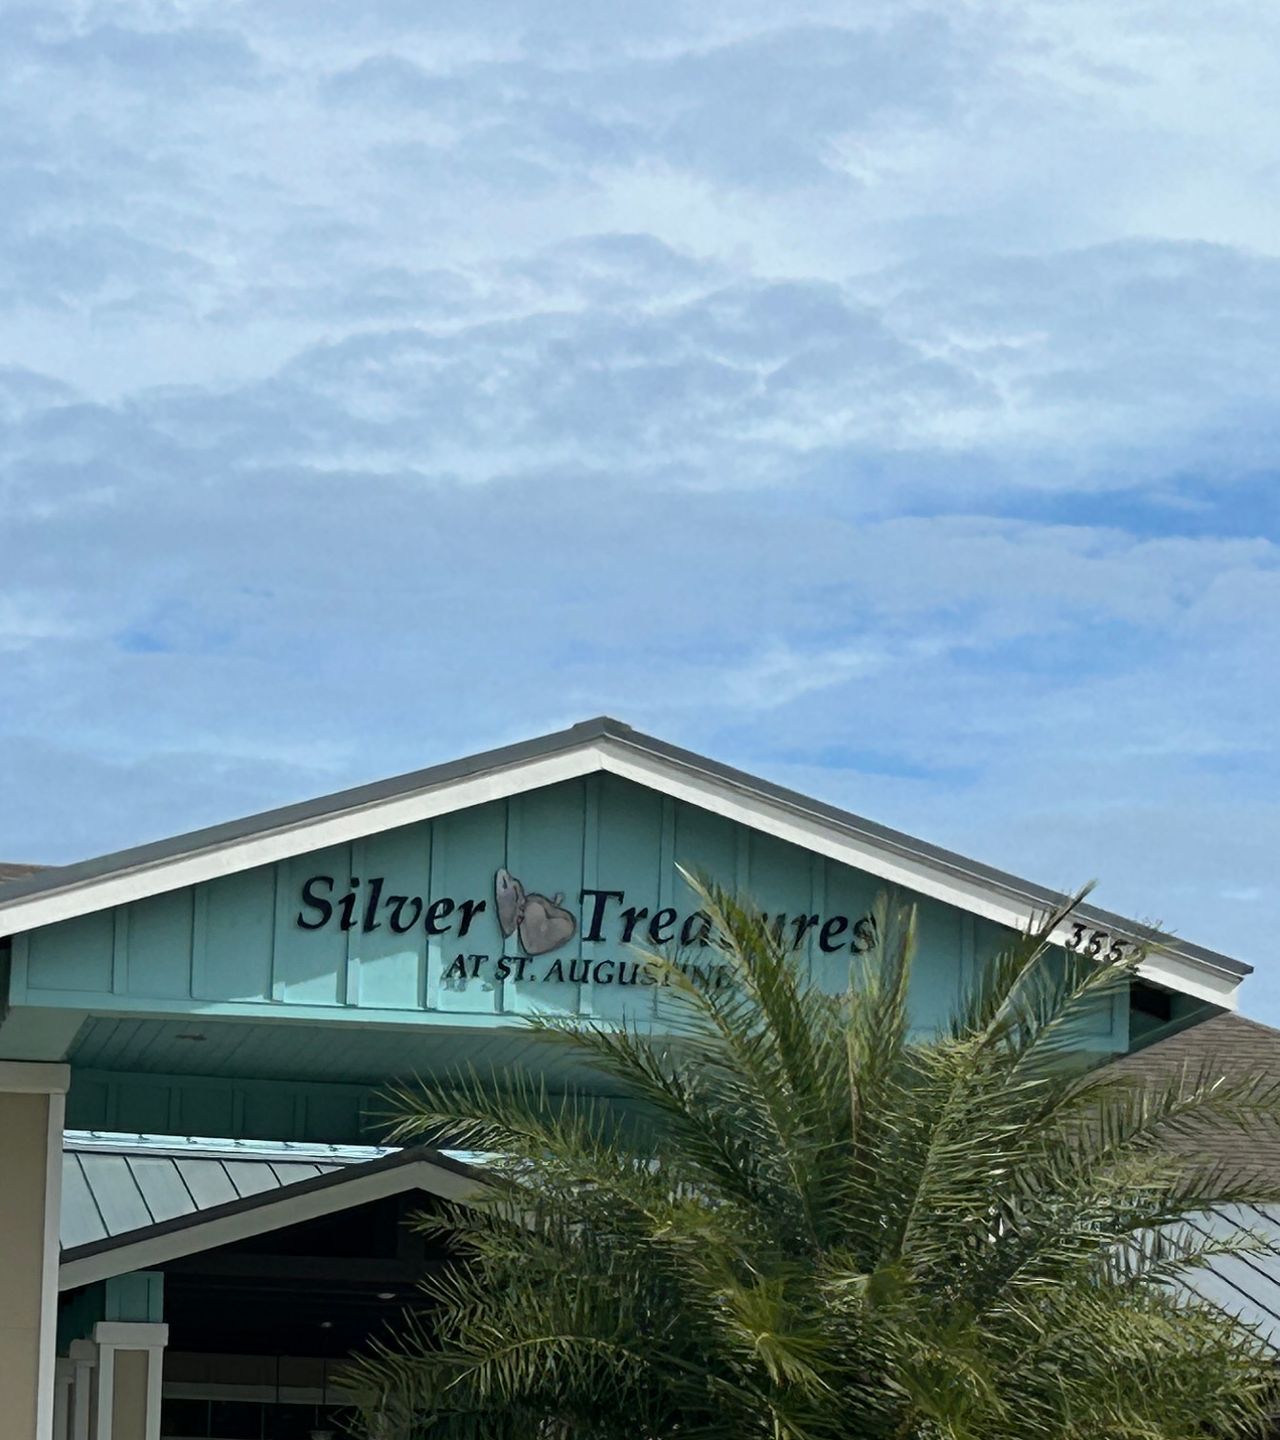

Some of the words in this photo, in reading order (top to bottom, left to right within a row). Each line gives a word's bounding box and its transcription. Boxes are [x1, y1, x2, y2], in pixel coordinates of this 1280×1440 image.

[297, 876, 487, 938] Silver
[579, 888, 880, 955] Treaures
[446, 953, 489, 978] AT
[494, 956, 537, 982] ST.
[1065, 922, 1144, 975] 355
